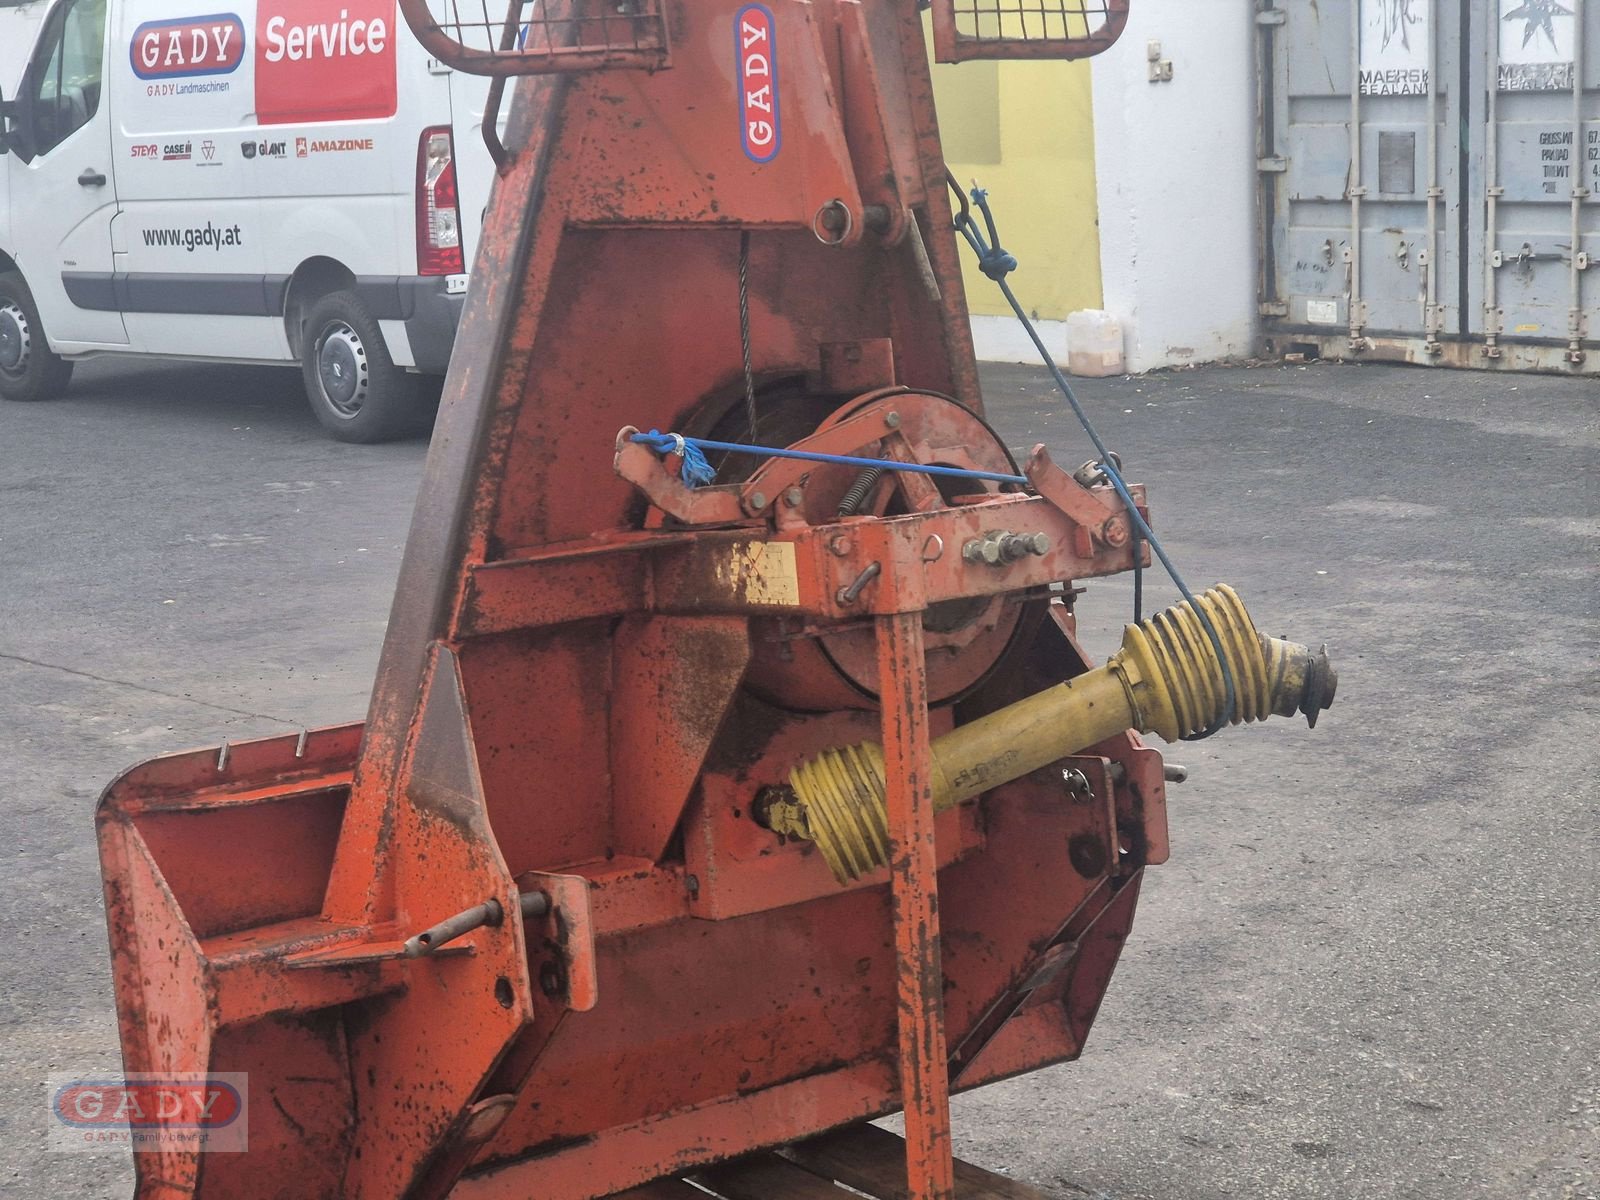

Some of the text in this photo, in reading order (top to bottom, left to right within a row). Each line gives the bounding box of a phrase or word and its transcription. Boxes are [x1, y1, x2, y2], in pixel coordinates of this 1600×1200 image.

[265, 9, 386, 62] Service
[141, 25, 233, 68] GADY
[742, 21, 773, 146] GADY
[1359, 69, 1428, 84] MAERSK
[147, 80, 230, 96] GADY Landmaschinen
[131, 144, 158, 157] STEYR
[163, 144, 185, 155] CASE
[310, 138, 373, 153] AMAZONE
[142, 221, 242, 252] www.gady.at
